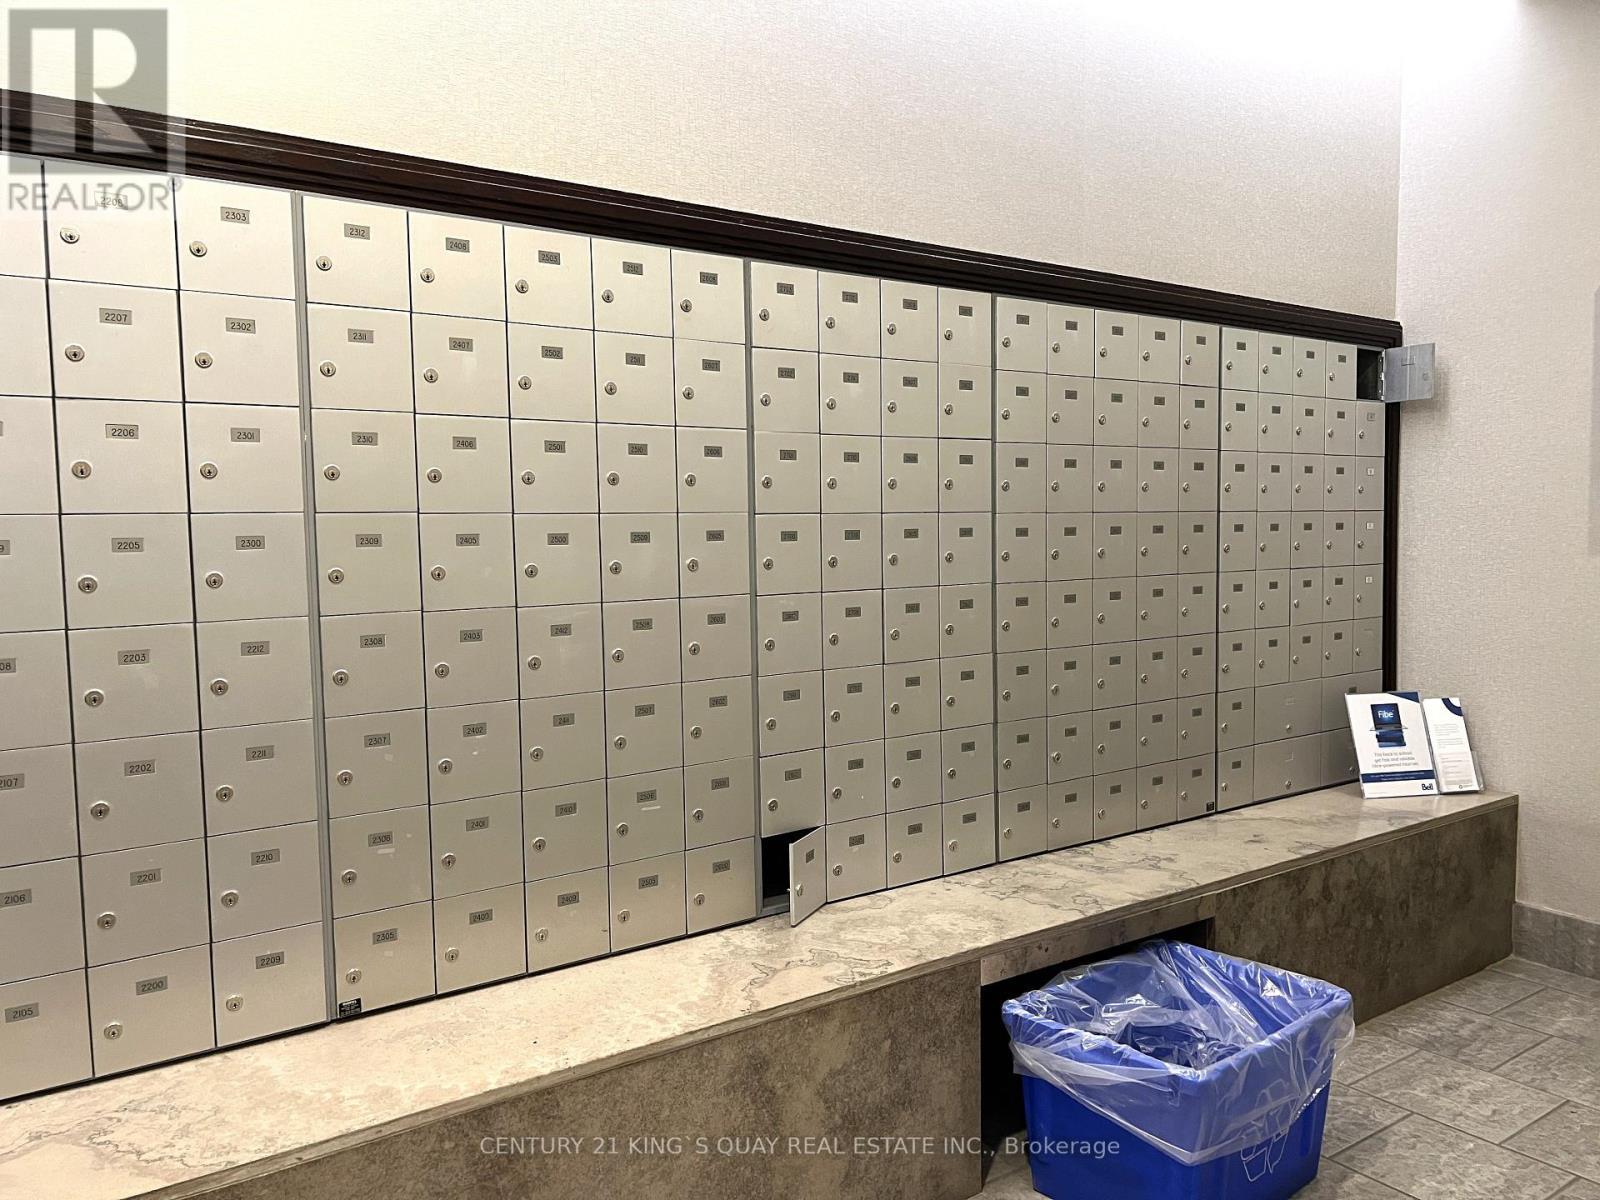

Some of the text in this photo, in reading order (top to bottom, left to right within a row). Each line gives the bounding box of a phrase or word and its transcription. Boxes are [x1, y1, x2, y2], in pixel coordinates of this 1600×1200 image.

[226, 211, 247, 221] 2303
[350, 227, 366, 237] 2312
[450, 241, 467, 251] 2408
[105, 313, 128, 323] 2207
[231, 322, 252, 331] 2302
[353, 332, 367, 341] 2311
[453, 341, 470, 349] 2407
[112, 428, 135, 437] 2206
[237, 432, 255, 440] 2301
[357, 436, 373, 444] 2310
[456, 440, 473, 448] 2406
[241, 540, 262, 548] 2300
[360, 537, 379, 545] 2309
[460, 536, 477, 544] 2405
[117, 541, 140, 550] 2205
[463, 632, 481, 640] 2403
[364, 637, 383, 646] 2308
[247, 645, 265, 653] 2212
[123, 654, 146, 662] 2203
[467, 725, 484, 735] 2402
[369, 737, 386, 746] 2307
[252, 749, 267, 758] 2211
[129, 763, 152, 774] 2202
[256, 854, 273, 863] 2210
[137, 873, 156, 883] 2201
[4, 894, 26, 905] 2106
[377, 932, 394, 942] 2305
[261, 956, 281, 967] 2209
[141, 981, 163, 992] 2200
[13, 1008, 33, 1019] 2105
